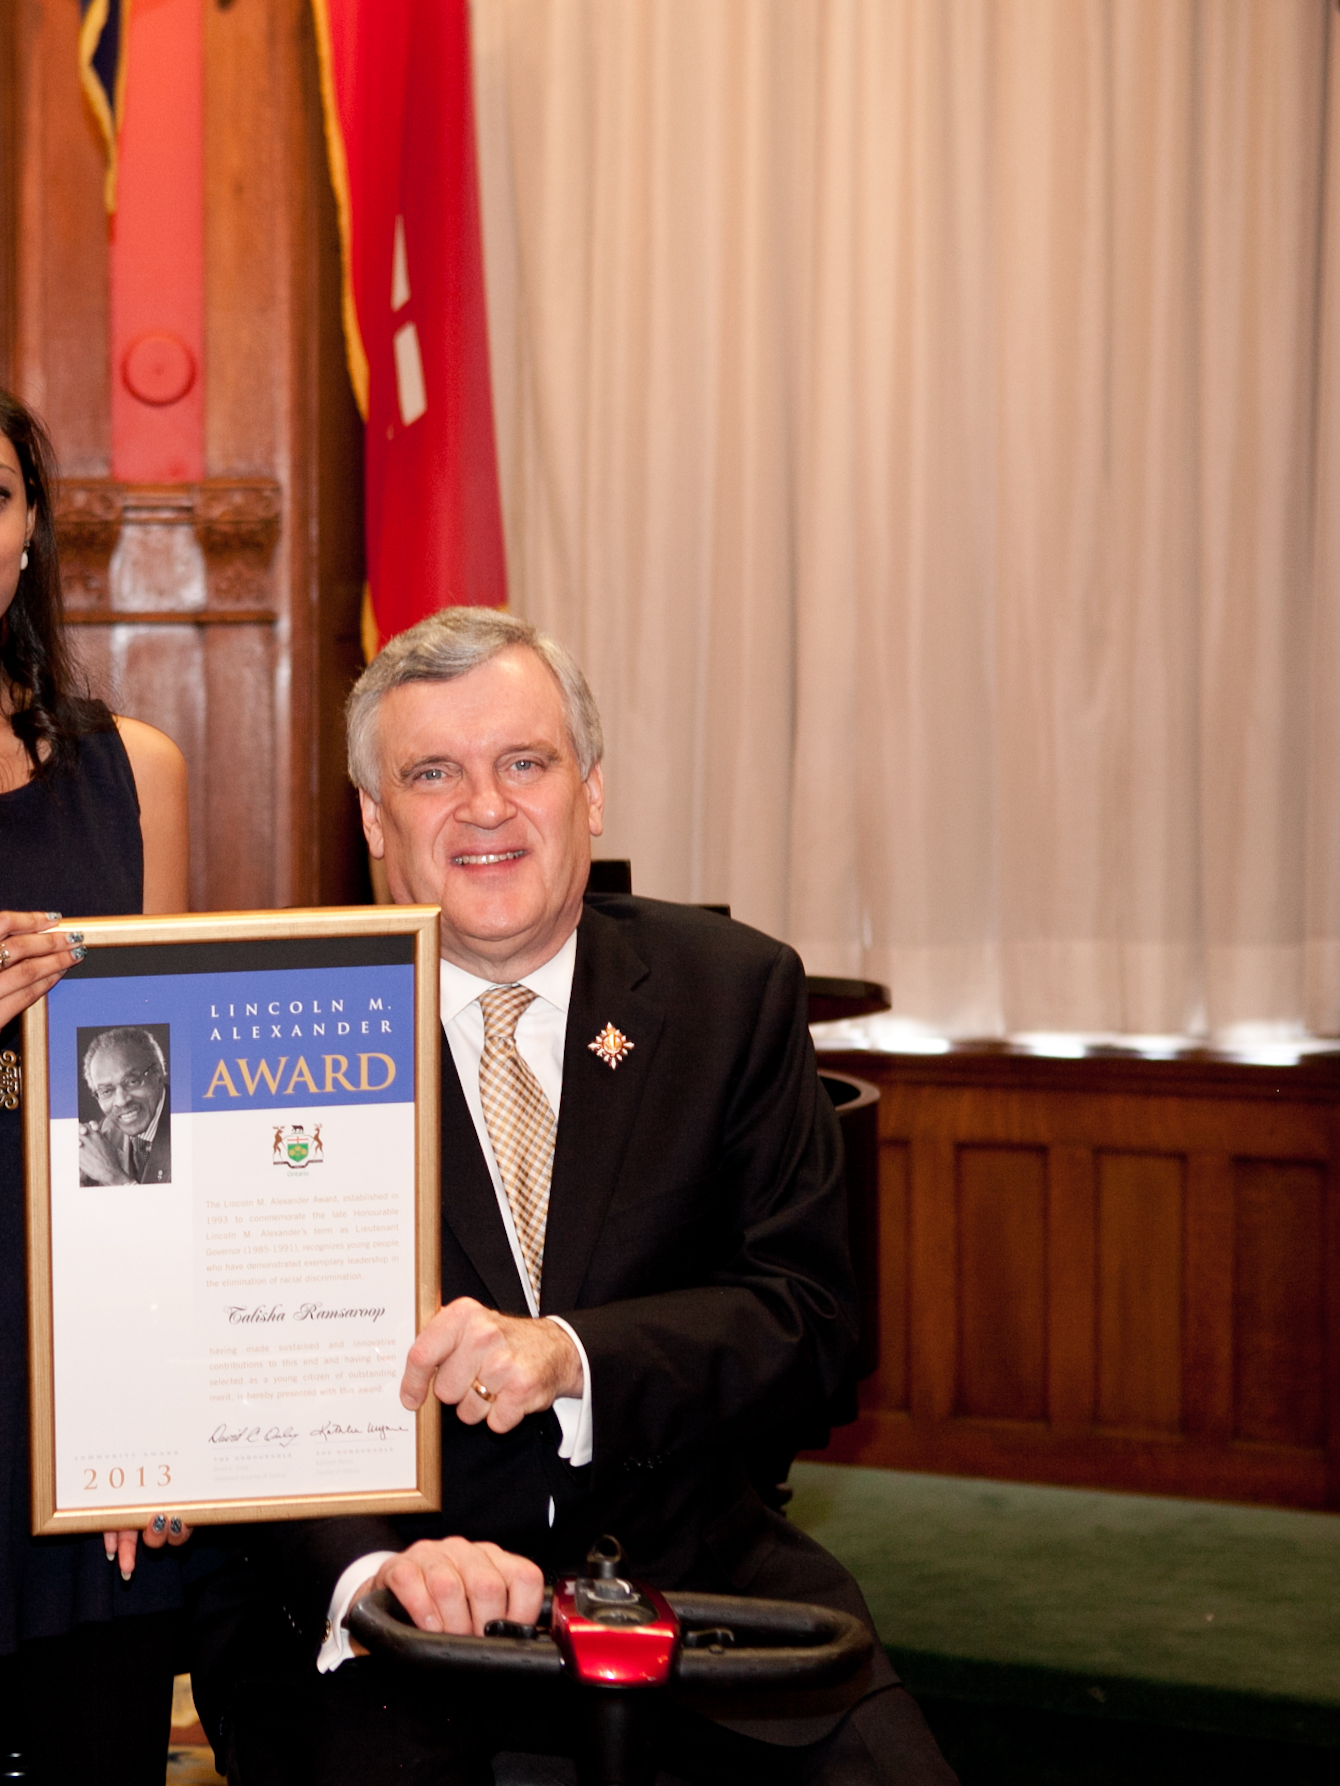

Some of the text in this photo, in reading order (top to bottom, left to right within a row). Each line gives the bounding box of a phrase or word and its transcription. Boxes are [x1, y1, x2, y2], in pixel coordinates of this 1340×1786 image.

[211, 998, 391, 1018] LINCOLN M.
[210, 1020, 392, 1041] ALEXANDER
[202, 1052, 396, 1098] AWARD
[205, 1201, 221, 1209] The
[224, 1200, 253, 1208] Lincoln
[270, 1197, 309, 1206] Alexander
[313, 1195, 340, 1204] Award,
[342, 1193, 388, 1202] established
[206, 1216, 228, 1224] 1993
[249, 1213, 306, 1223] commemorate
[332, 1211, 347, 1219] late
[353, 1208, 399, 1217] Honourable
[206, 1232, 236, 1240] Lincoln
[314, 1227, 333, 1235] term
[355, 1224, 399, 1233] Lieutenant
[206, 1239, 399, 1256] Governor (1985-1991), recognizes young people
[206, 1264, 222, 1272] who
[225, 1263, 244, 1271] have
[247, 1260, 301, 1270] demonstrated
[304, 1258, 344, 1268] exemplary
[347, 1256, 388, 1266] leadership
[206, 1280, 219, 1288] the
[222, 1277, 266, 1287] elimination
[280, 1275, 302, 1283] racial
[305, 1272, 364, 1282] discrimination.
[223, 1302, 386, 1325] Talisha Ramsaroop
[209, 1338, 396, 1355] having made sustained and innovative
[209, 1354, 396, 1371] contributions to this end and having been
[209, 1377, 243, 1386] selected
[273, 1375, 298, 1385] young
[303, 1372, 330, 1381] citizen
[335, 1371, 344, 1379] of
[348, 1369, 396, 1379] outstanding
[209, 1393, 234, 1402] merit,
[237, 1392, 244, 1400] is
[247, 1391, 273, 1400] hereby
[277, 1389, 317, 1399] presented
[320, 1387, 336, 1396] with
[340, 1386, 355, 1394] this
[83, 1464, 171, 1490] 2013
